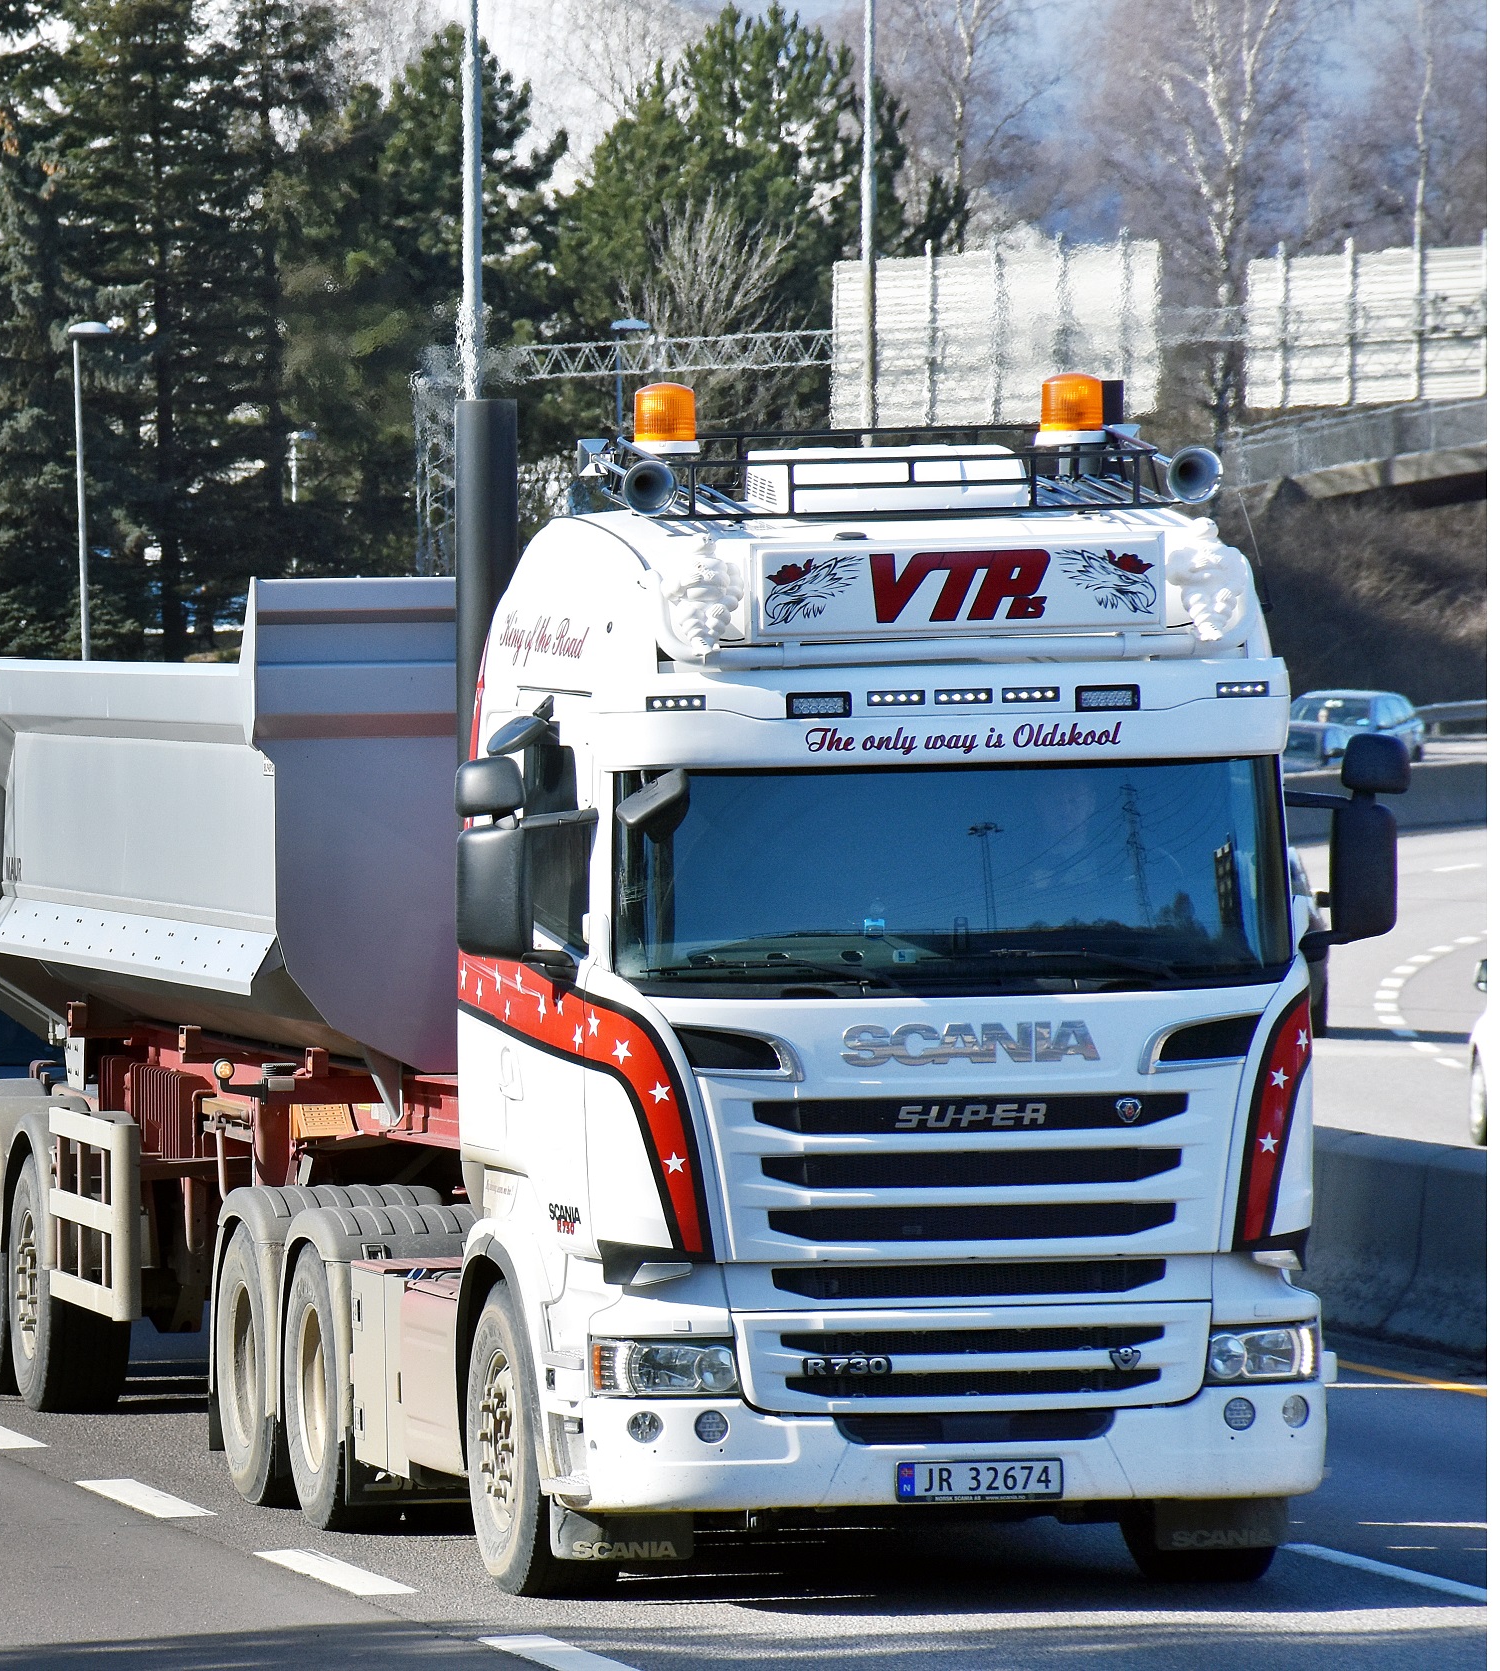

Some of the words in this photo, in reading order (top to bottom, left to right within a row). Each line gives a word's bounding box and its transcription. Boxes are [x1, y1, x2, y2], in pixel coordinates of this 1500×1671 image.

[499, 610, 526, 666] King
[525, 615, 542, 667] of
[535, 616, 552, 653] the
[552, 617, 590, 659] Road
[805, 727, 855, 752] The
[861, 726, 918, 755] only
[924, 732, 979, 754] way
[985, 727, 1005, 748] is
[1012, 721, 1123, 747] Oldskool
[840, 1020, 1101, 1067] SCANIA
[895, 1103, 1047, 1128] SUPER
[548, 1203, 581, 1224] SCANIA
[556, 1220, 562, 1233] R
[563, 1221, 575, 1235] 730
[807, 1359, 827, 1375] R
[831, 1357, 888, 1375] 730
[903, 1484, 911, 1492] N
[924, 1467, 953, 1492] JR
[968, 1465, 1052, 1491] 32674
[572, 1541, 678, 1559] SCANIA
[1171, 1529, 1274, 1548] SCANIA
